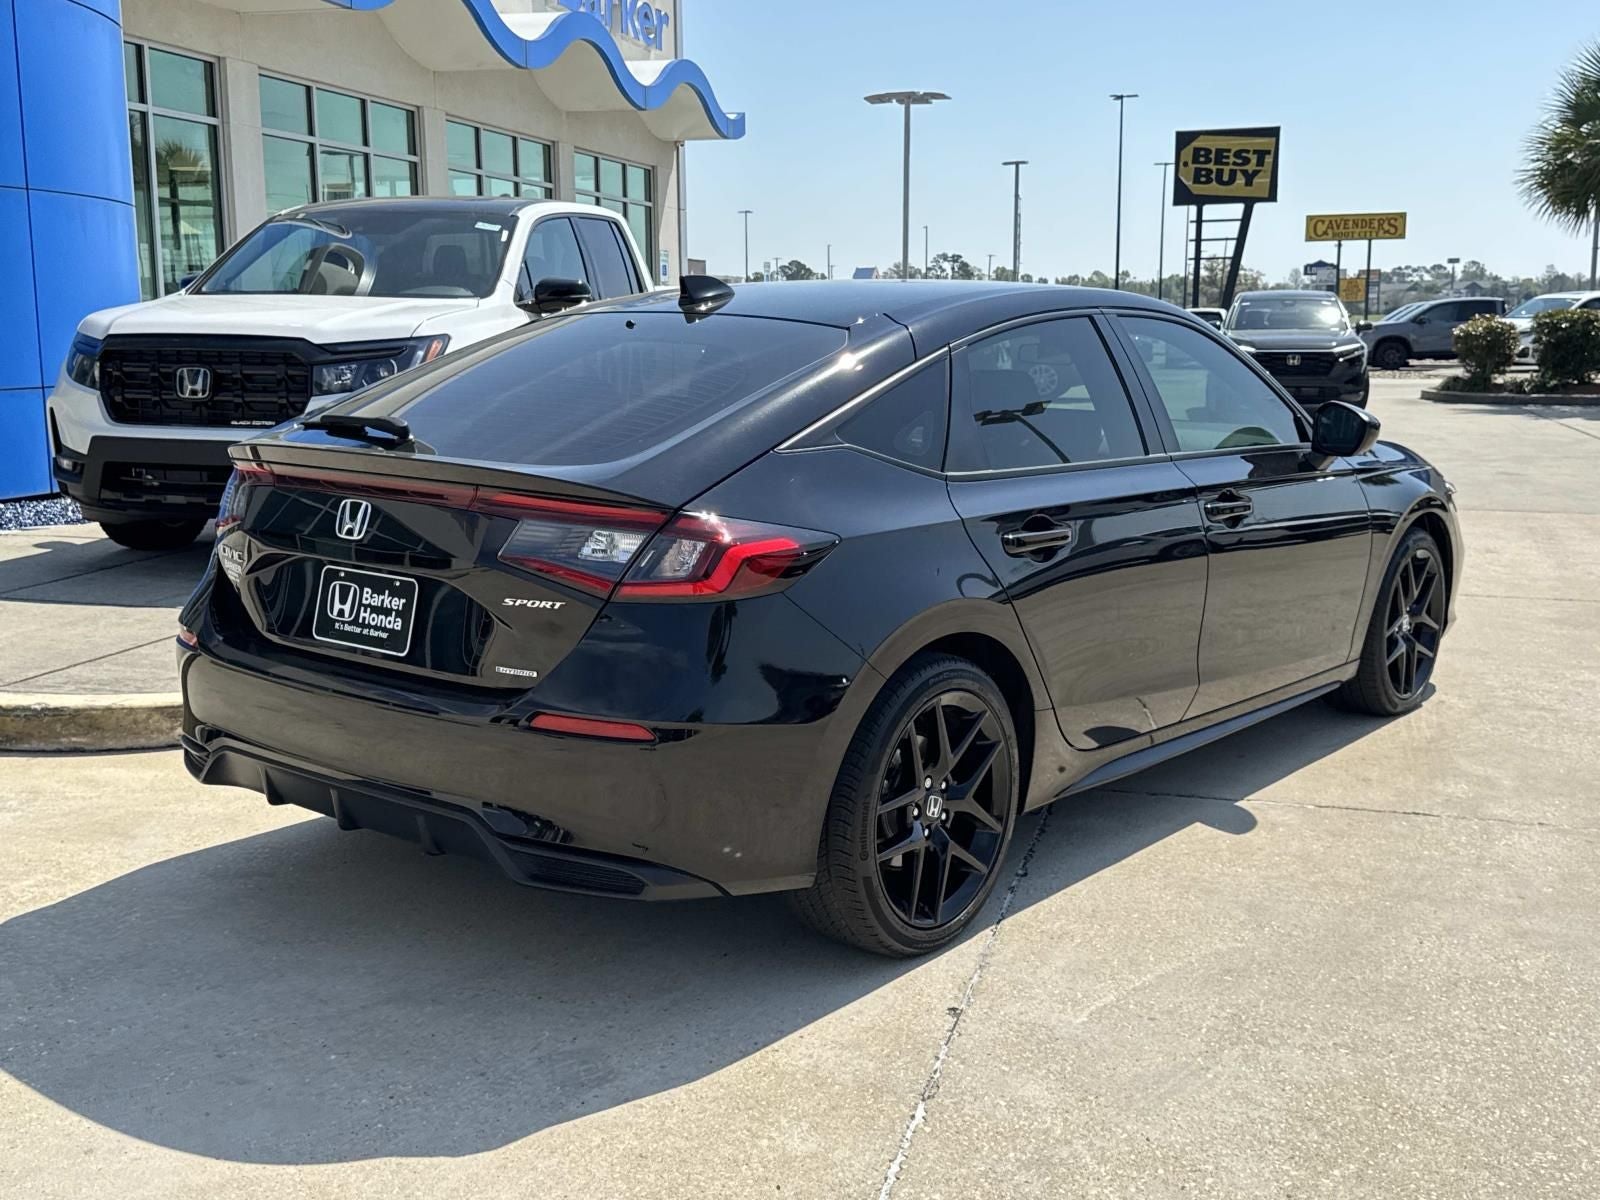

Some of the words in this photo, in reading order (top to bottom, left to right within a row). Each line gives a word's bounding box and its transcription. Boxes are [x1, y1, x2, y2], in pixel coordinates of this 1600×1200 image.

[558, 0, 669, 51] rker
[1191, 147, 1272, 167] BEST
[1192, 167, 1263, 187] BUY
[1312, 216, 1398, 237] CAVENDER'S
[361, 587, 406, 610] Barker
[502, 597, 567, 610] SPORT
[358, 606, 402, 630] Honda
[334, 621, 344, 630] It's
[343, 623, 362, 634] Better
[362, 628, 370, 636] at
[369, 628, 389, 639] Barker
